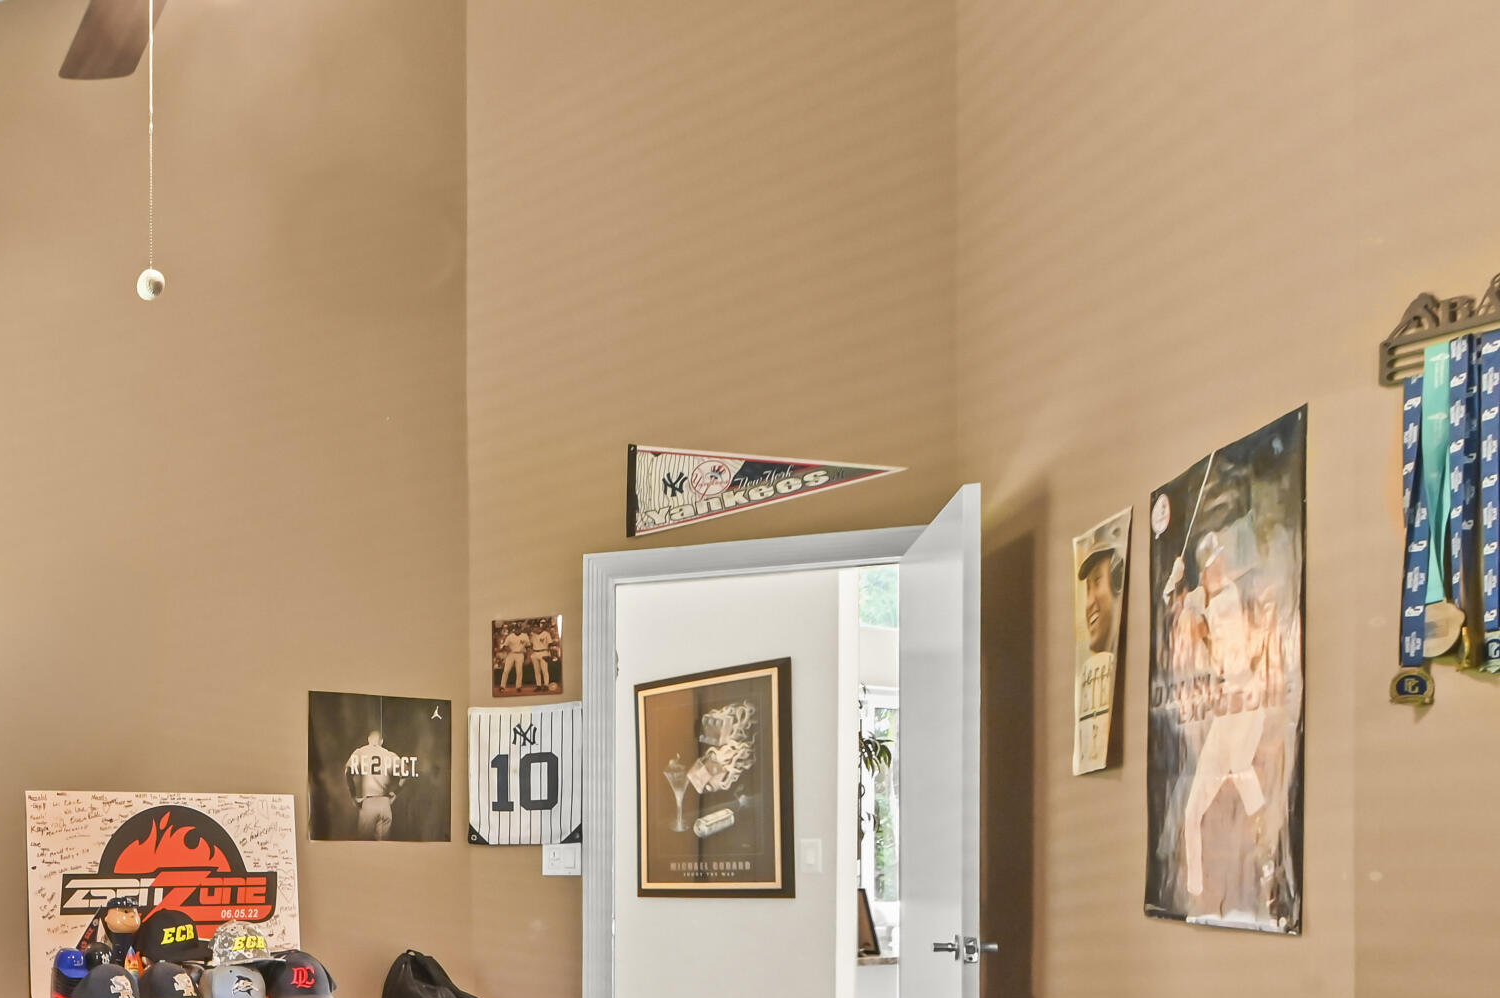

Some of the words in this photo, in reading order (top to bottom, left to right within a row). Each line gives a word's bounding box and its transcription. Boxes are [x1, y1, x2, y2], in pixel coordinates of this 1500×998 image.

[662, 471, 689, 497] NY
[734, 475, 764, 491] New
[762, 464, 795, 485] York
[646, 469, 830, 526] Yankees
[512, 723, 538, 746] NY
[491, 751, 559, 812] 10
[220, 908, 259, 918] 06.05.22
[161, 923, 194, 945] ECB
